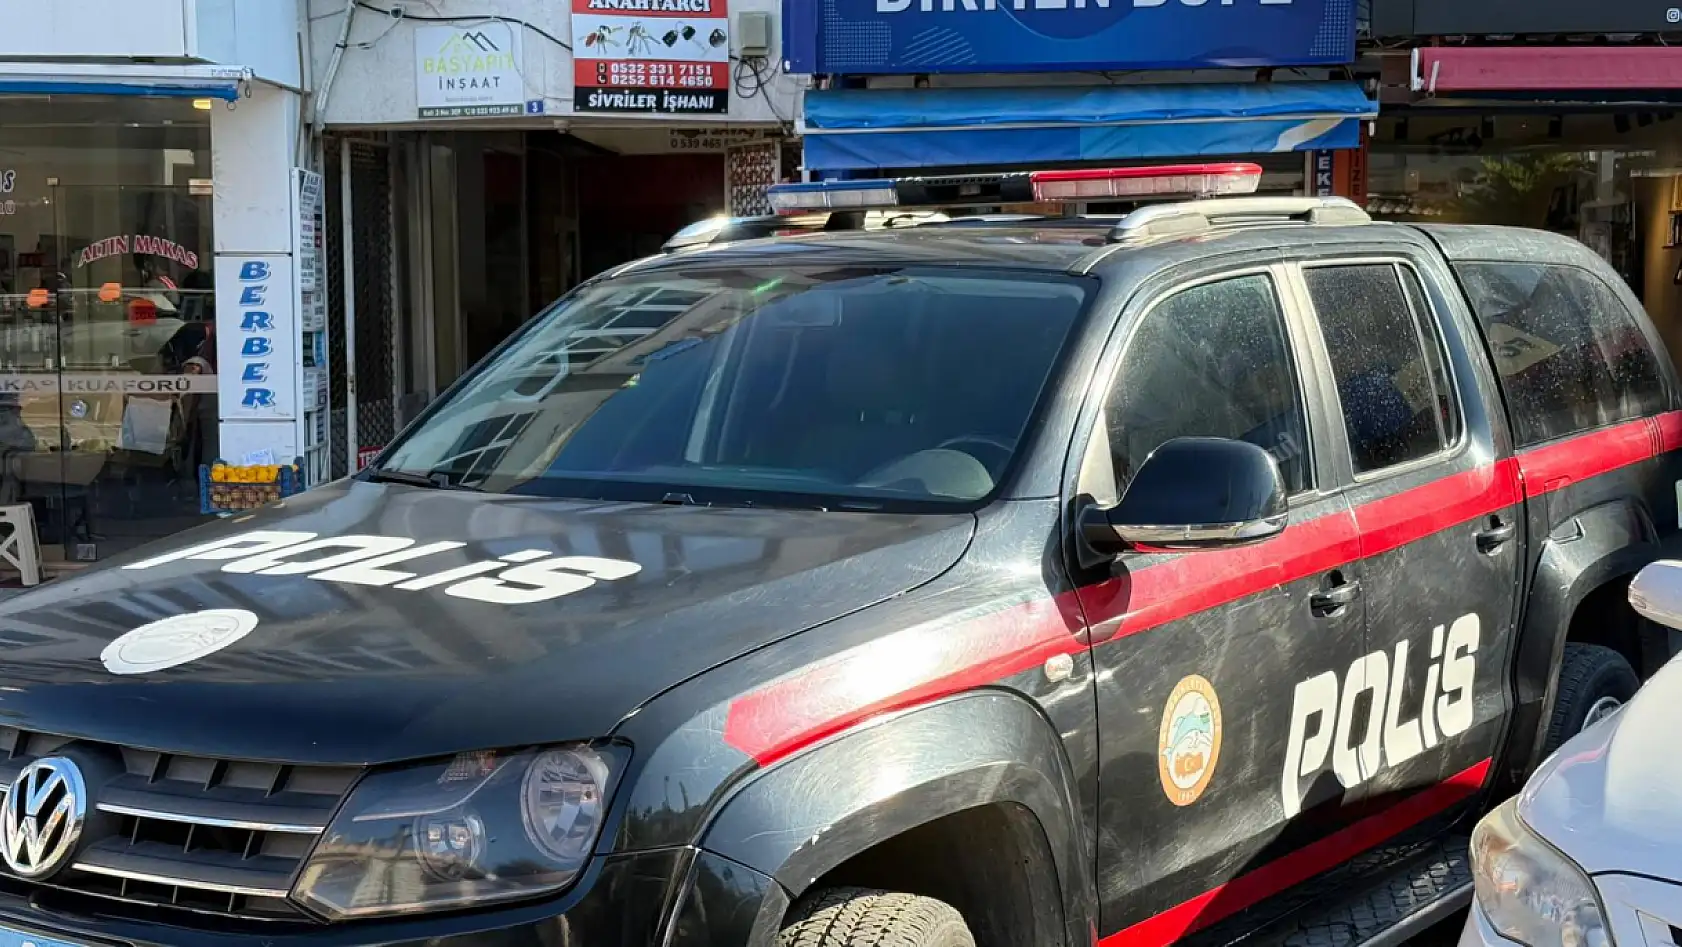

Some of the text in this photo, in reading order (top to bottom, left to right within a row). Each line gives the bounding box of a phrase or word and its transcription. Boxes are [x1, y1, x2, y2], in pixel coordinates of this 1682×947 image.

[610, 63, 711, 75] 0532 331 7151
[610, 75, 713, 87] 0252 614 4650
[588, 89, 714, 112] SİVRİLER İŞHANI
[78, 235, 199, 269] ALTIN MAKAS
[239, 261, 276, 409] BERBER
